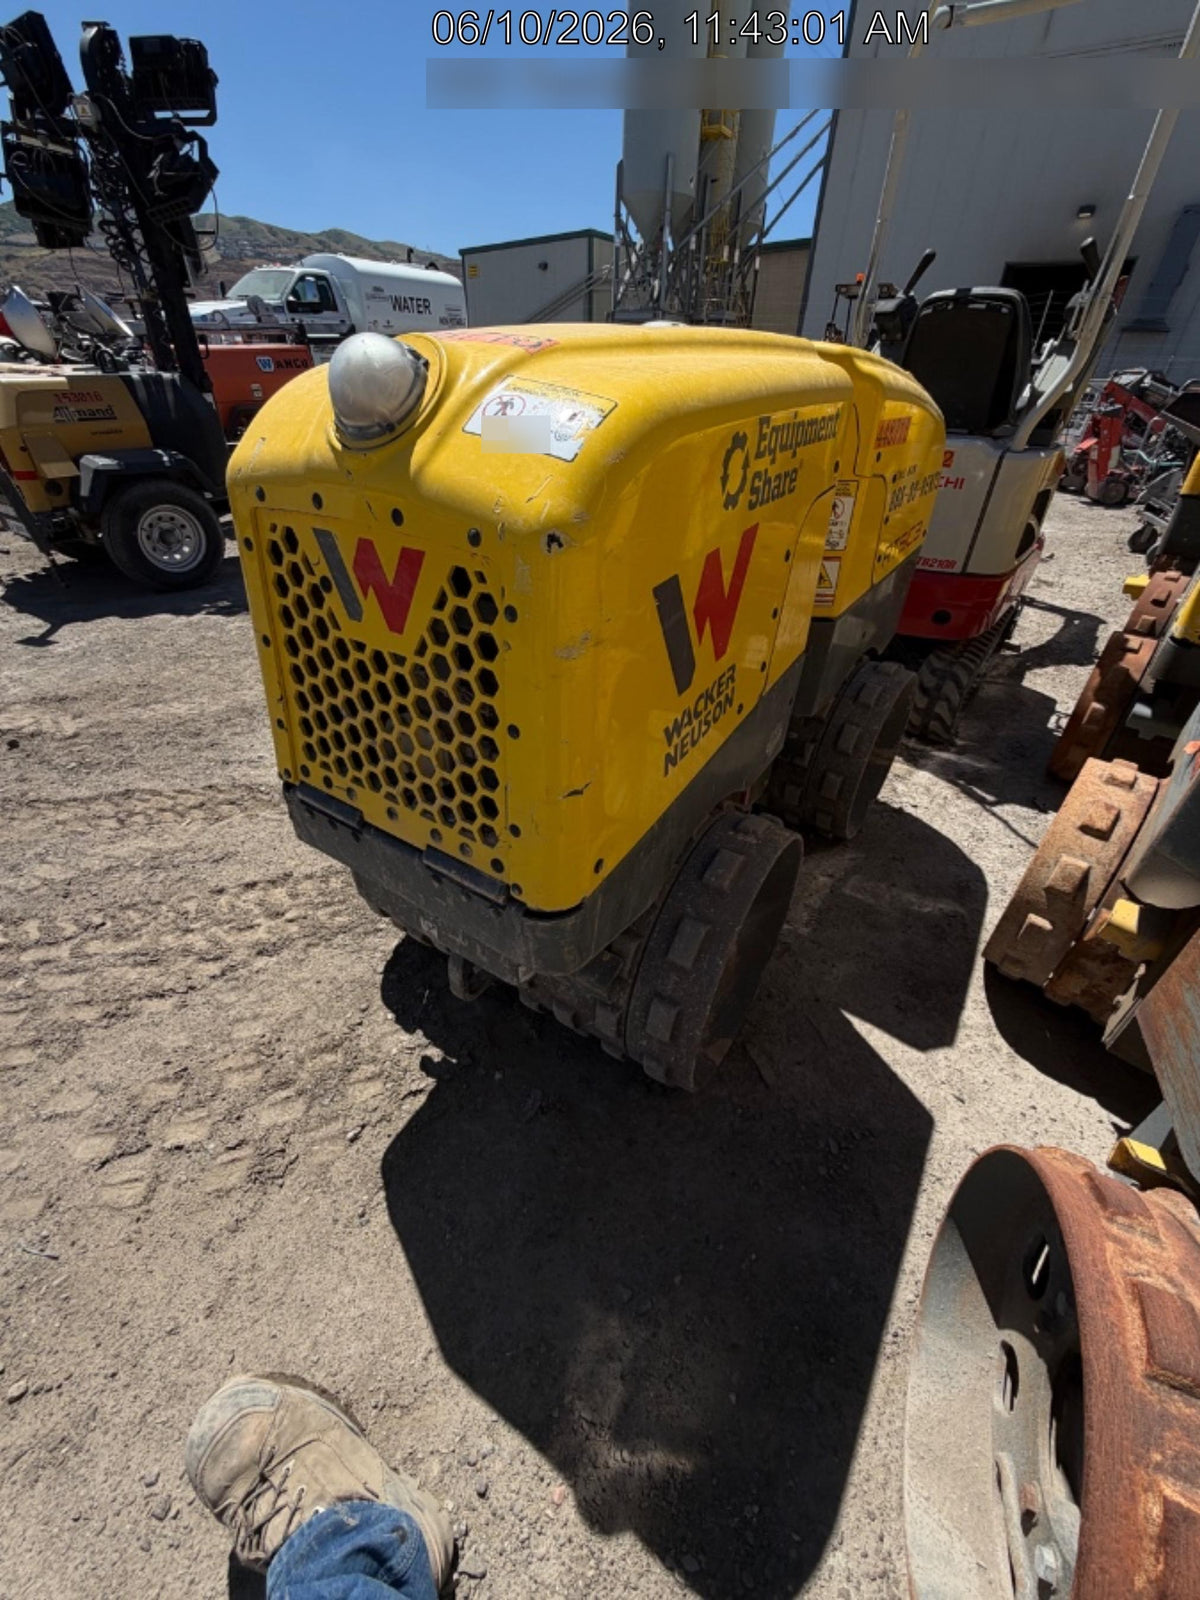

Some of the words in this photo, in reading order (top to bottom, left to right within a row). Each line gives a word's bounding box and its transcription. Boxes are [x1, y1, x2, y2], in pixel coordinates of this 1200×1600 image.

[391, 293, 432, 316] WATER
[755, 408, 841, 465] Equipment
[748, 468, 799, 512] Share
[663, 663, 737, 748] WACKER
[663, 687, 735, 779] NEUSON
